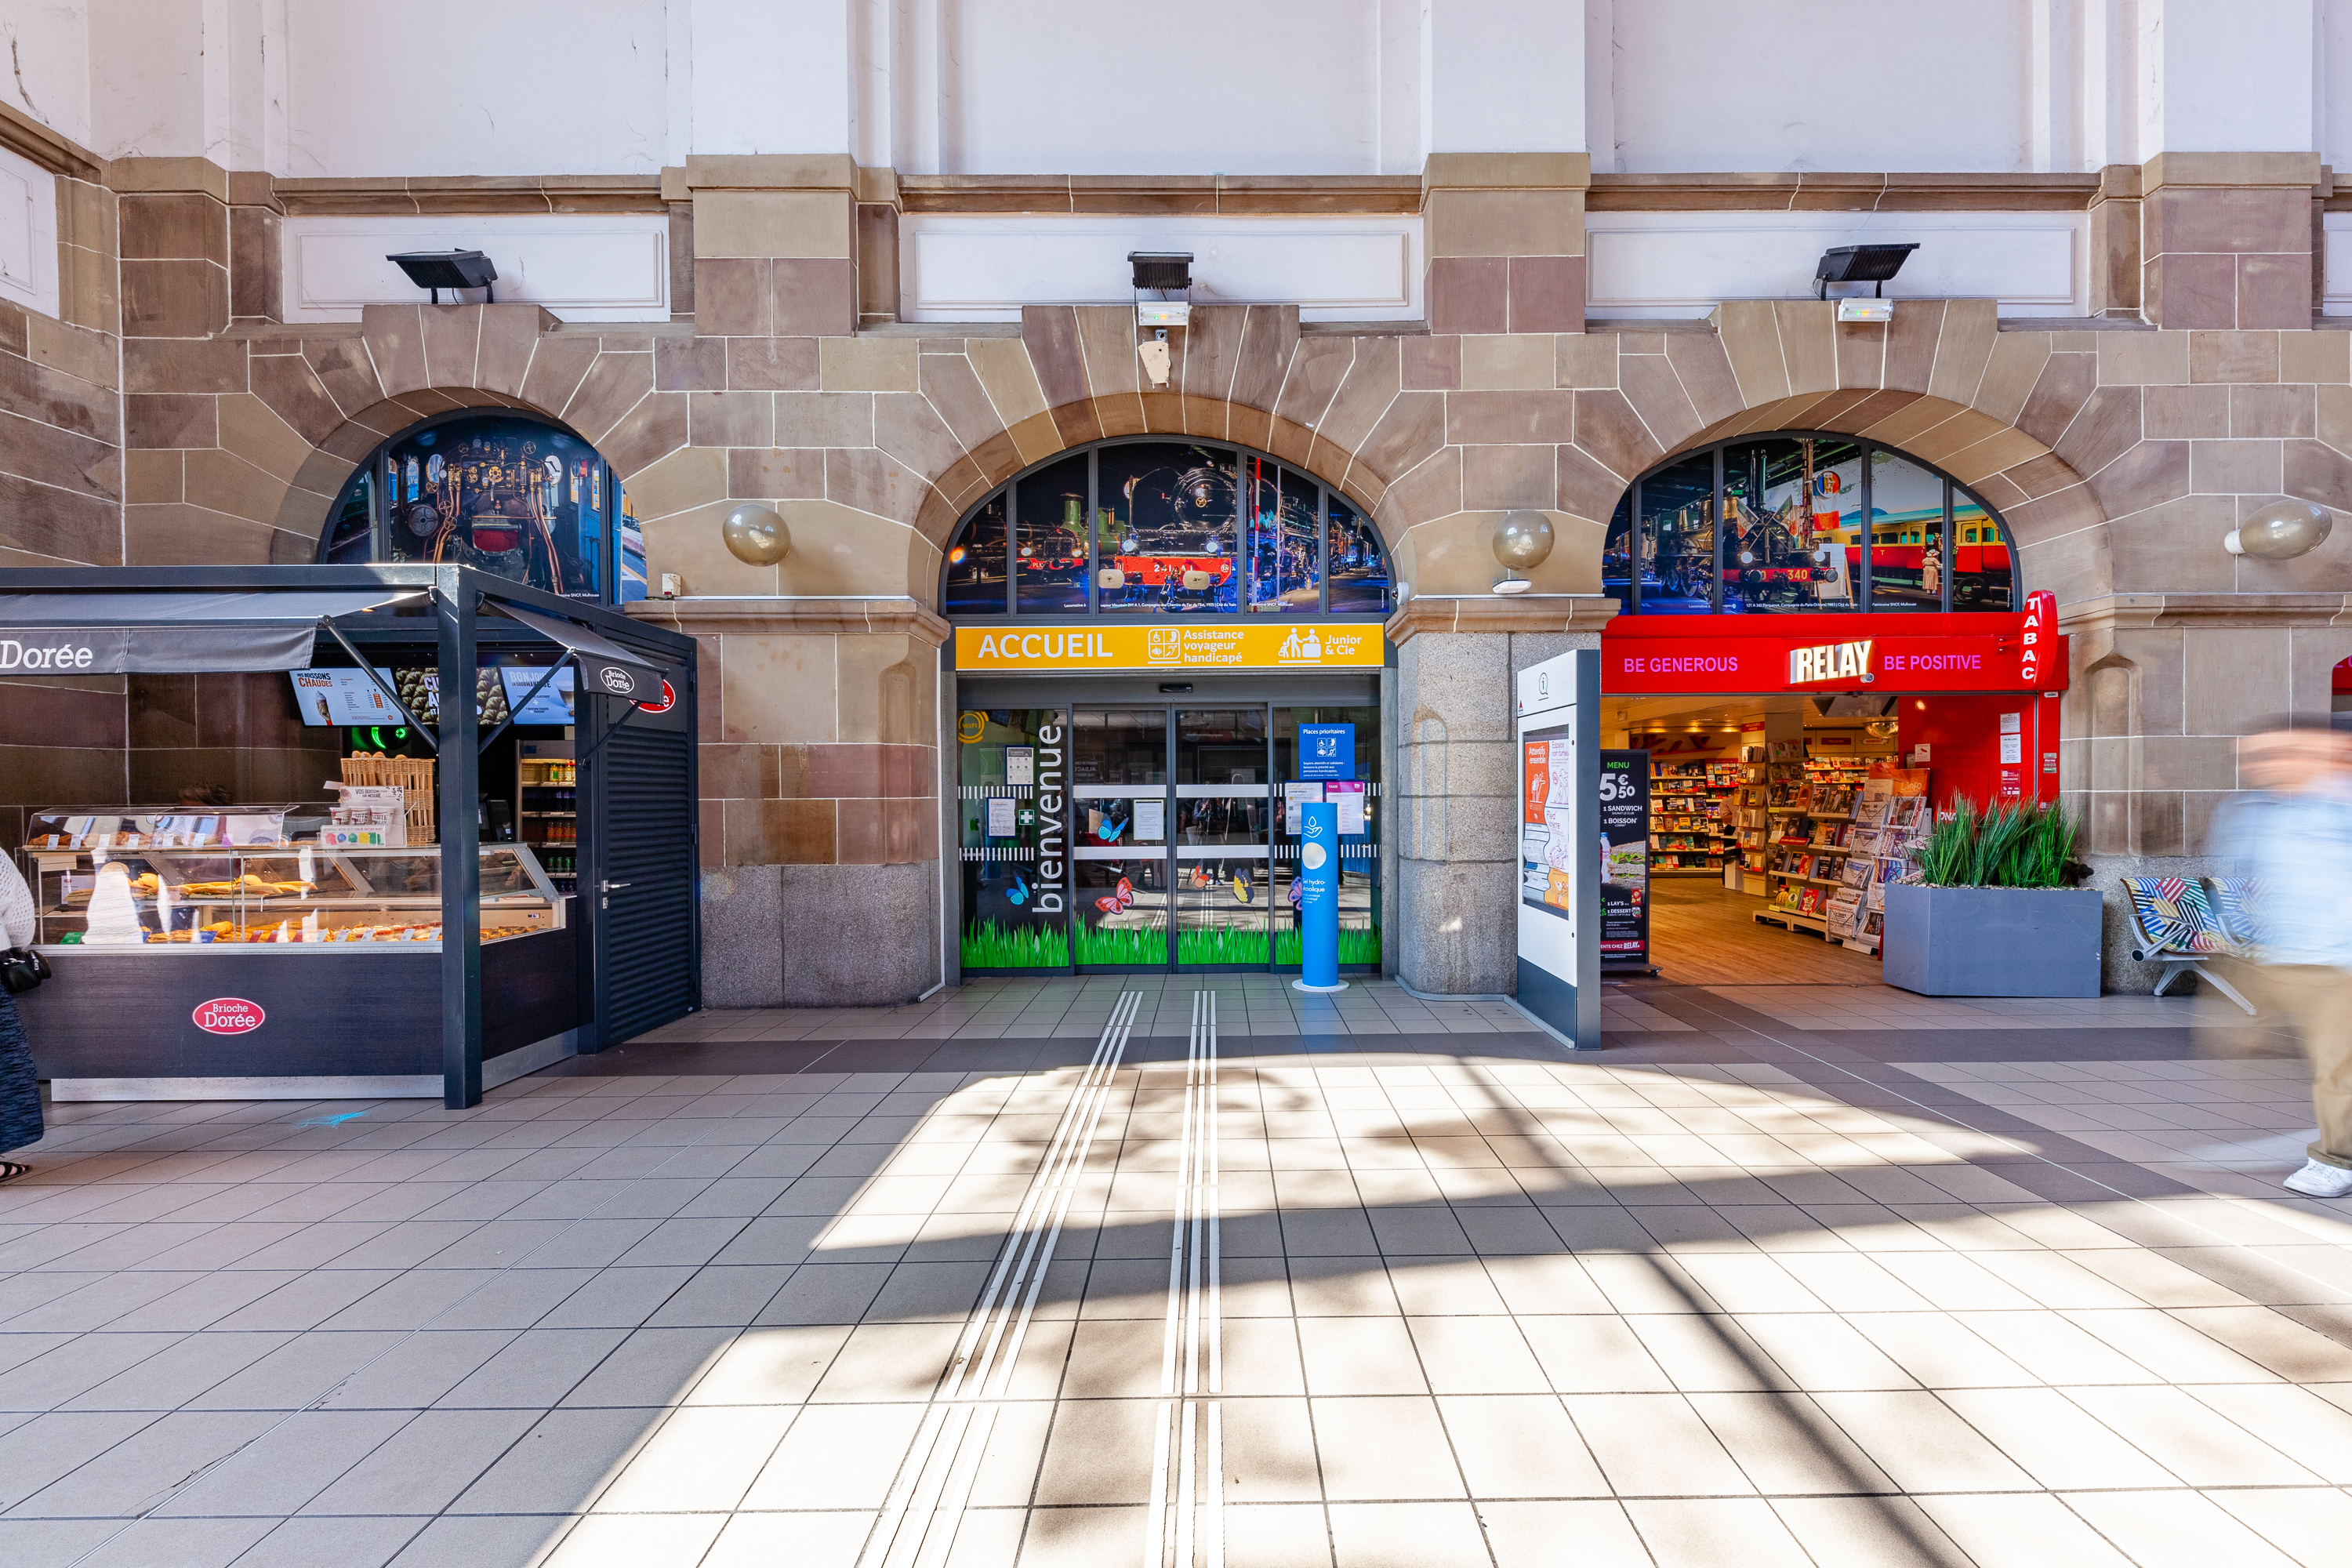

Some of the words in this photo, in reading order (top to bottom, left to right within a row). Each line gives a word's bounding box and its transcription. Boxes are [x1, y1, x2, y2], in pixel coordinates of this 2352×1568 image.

[1788, 569, 1808, 580] 340
[1184, 630, 1244, 640] Assistance
[1325, 634, 1362, 645] Junior
[2022, 597, 2040, 680] TABAC
[977, 633, 1113, 659] ACCUEIL
[1184, 641, 1236, 652] voyageur
[1325, 645, 1334, 655] &
[1337, 645, 1356, 655] Cie
[0, 640, 93, 669] Dorée
[1184, 652, 1243, 665] handicapé
[1624, 658, 1645, 673] BE
[1650, 656, 1738, 673] GENEROUS
[1791, 639, 1872, 684] RELAY
[1884, 655, 1905, 670] BE
[1910, 655, 1981, 670] POSITIVE
[298, 677, 333, 688] CHAUDES
[1528, 746, 1546, 756] Attentifs
[1552, 742, 1565, 751] Espace
[1529, 755, 1546, 764] ensemble
[1900, 781, 1922, 791] L'info
[1032, 725, 1062, 913] bienvenue
[1308, 878, 1327, 887] hydro-
[212, 1004, 249, 1013] Brioche
[204, 1014, 256, 1028] Dorée
